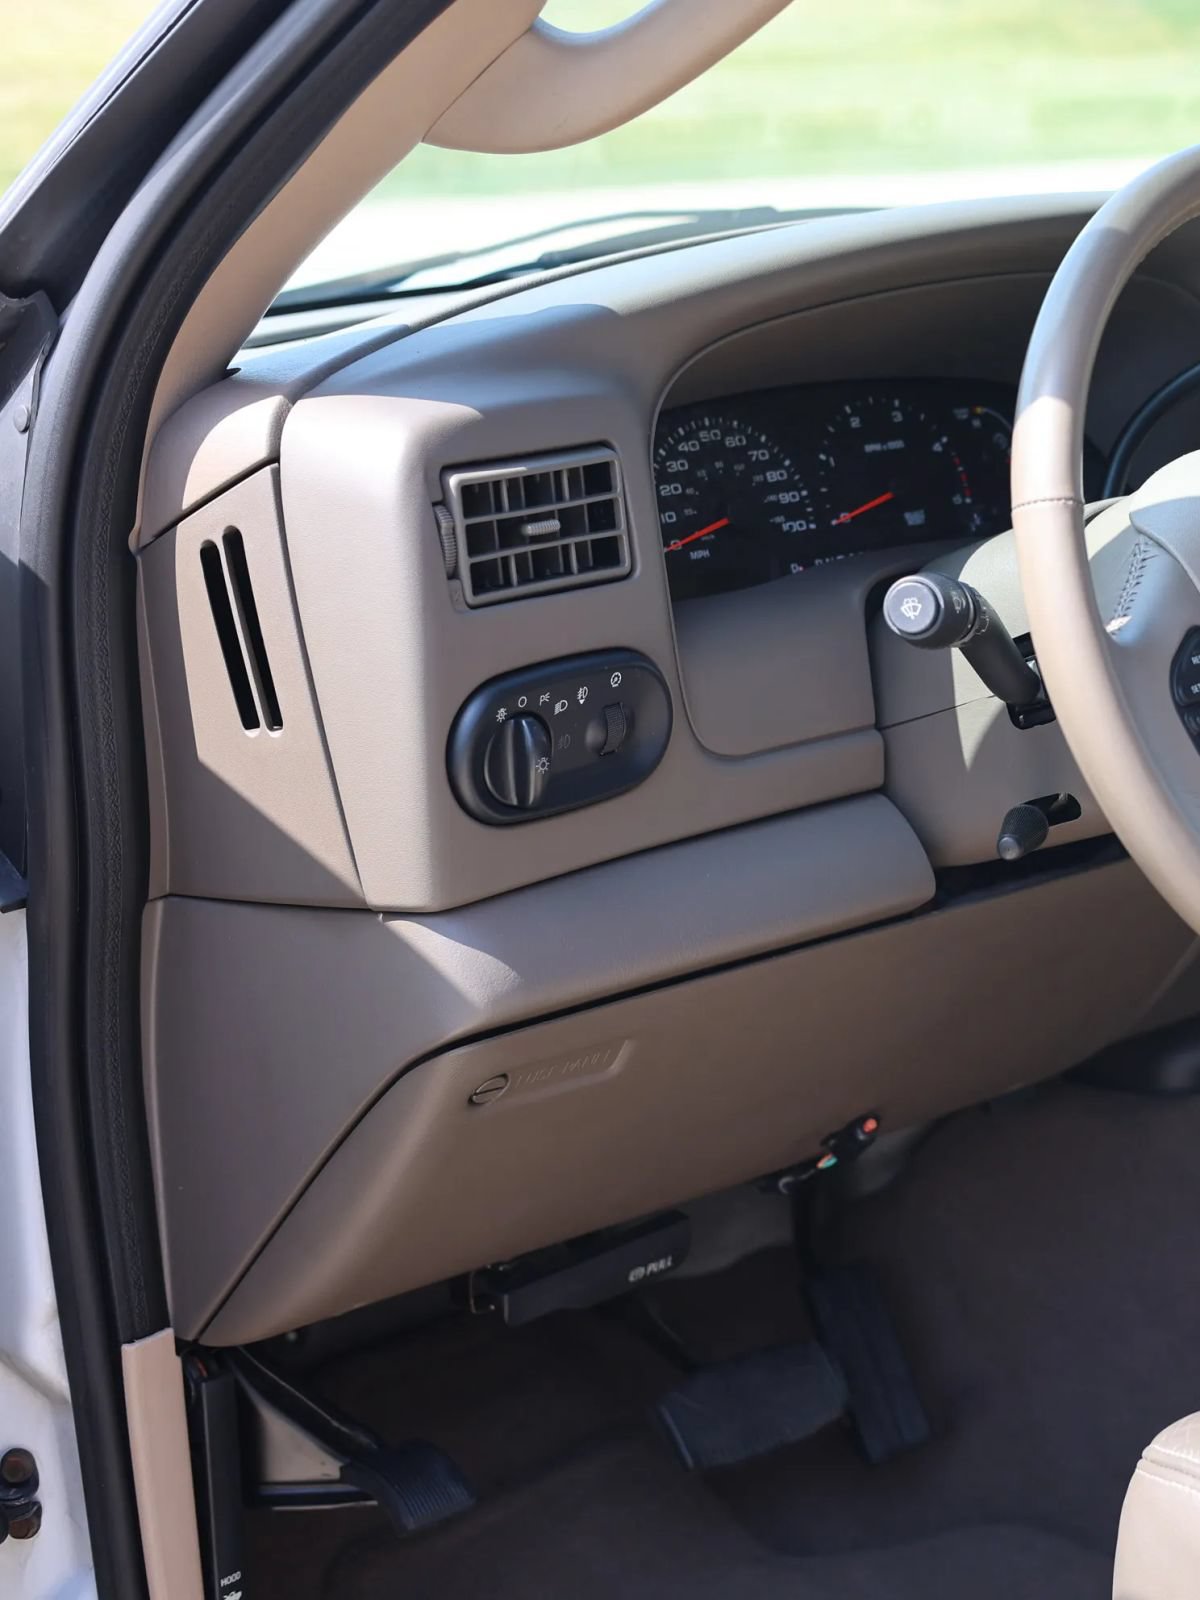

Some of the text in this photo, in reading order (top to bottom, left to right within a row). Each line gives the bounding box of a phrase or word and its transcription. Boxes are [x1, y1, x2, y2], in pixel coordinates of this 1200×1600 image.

[849, 416, 861, 429] 2
[891, 410, 904, 423] 3
[698, 429, 722, 443] 50
[724, 435, 748, 448] 60
[677, 440, 700, 453] 40
[747, 449, 770, 462] 70
[665, 459, 689, 473] 30
[765, 469, 788, 483] 80
[659, 483, 683, 497] 20
[778, 490, 800, 504] 90
[661, 511, 677, 524] 10
[782, 520, 807, 533] 100
[690, 548, 711, 560] MPH
[645, 1255, 673, 1277] PULL
[220, 1570, 242, 1588] HOOD
